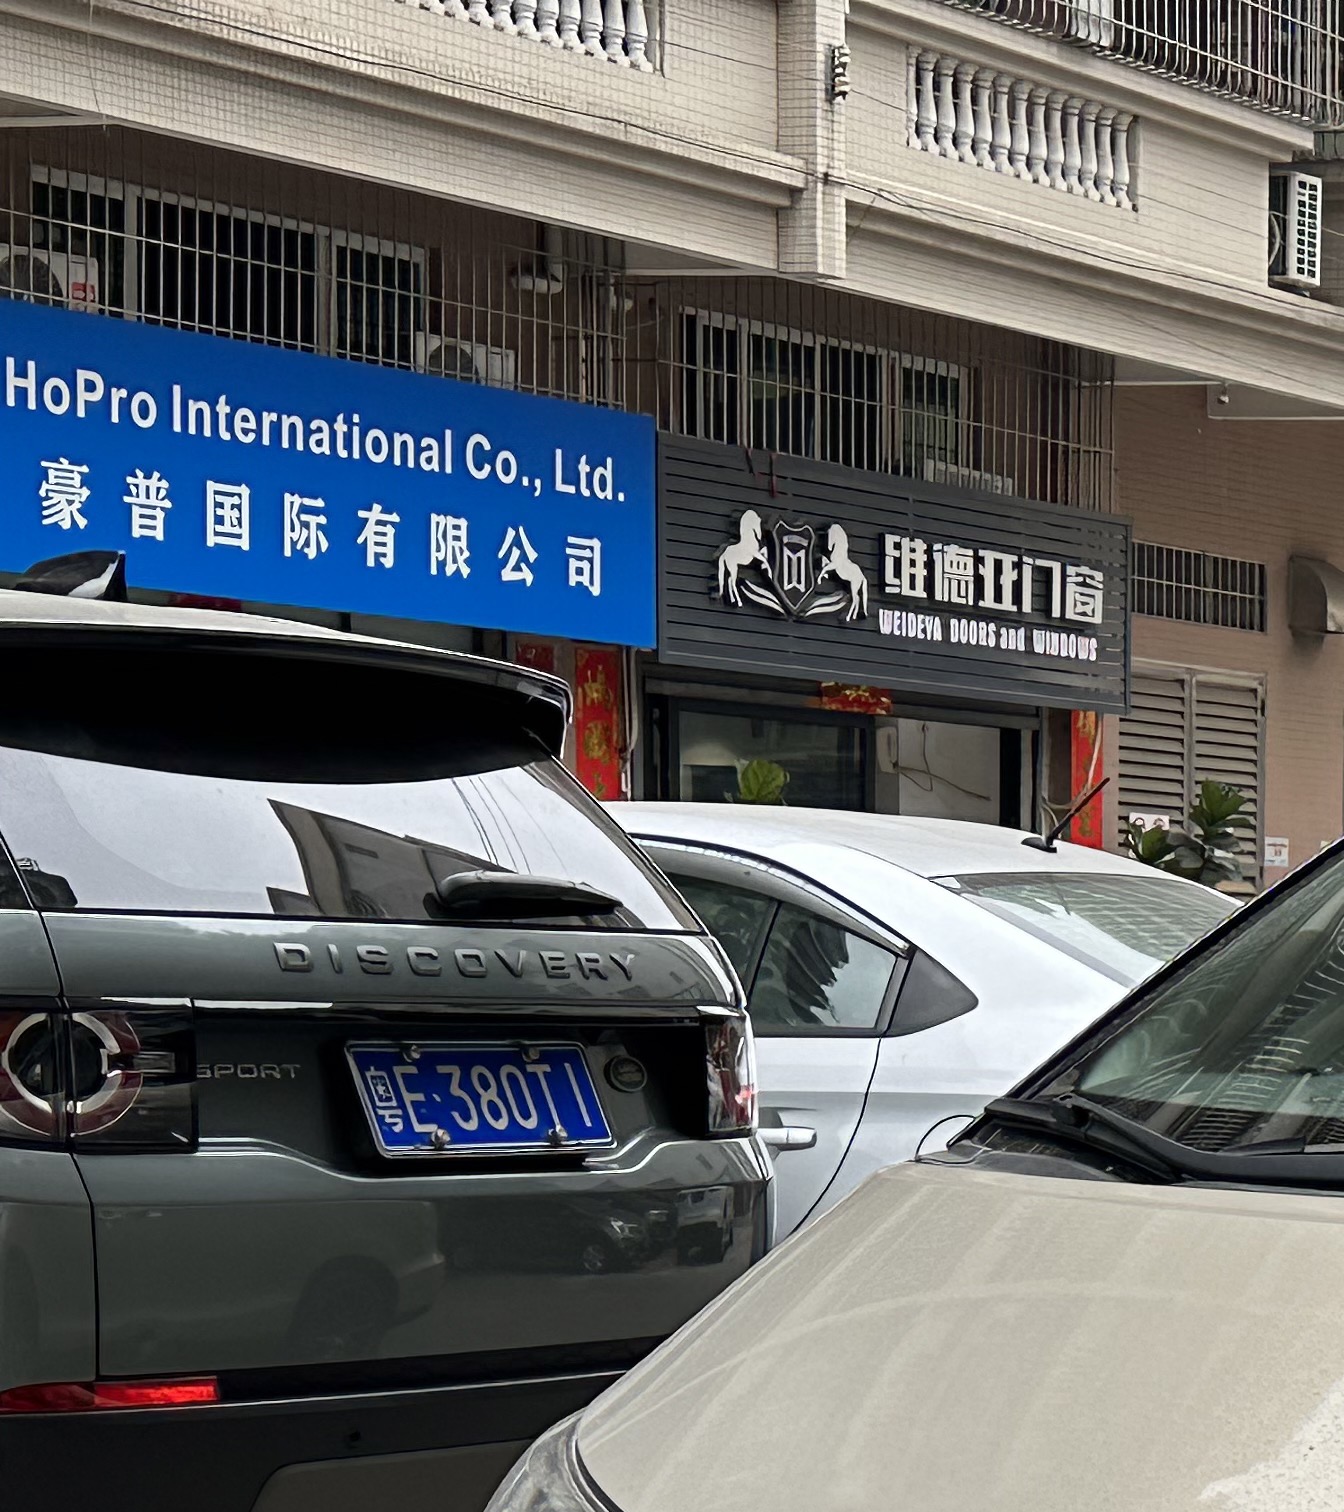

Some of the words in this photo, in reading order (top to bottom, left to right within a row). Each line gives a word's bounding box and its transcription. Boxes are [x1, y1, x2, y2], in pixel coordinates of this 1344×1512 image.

[5, 356, 158, 429] HoPro
[172, 383, 453, 475] International
[465, 432, 542, 498] Co.,
[554, 447, 626, 502] Ltd.
[38, 456, 602, 598] 豪普国际有限公司
[884, 533, 1104, 625] 维德亚门窗
[950, 617, 997, 648] DOORS
[999, 626, 1027, 652] and
[1032, 627, 1099, 662] WINDOWS
[272, 941, 636, 982] DISCOVERY
[196, 1063, 301, 1080] SPORT
